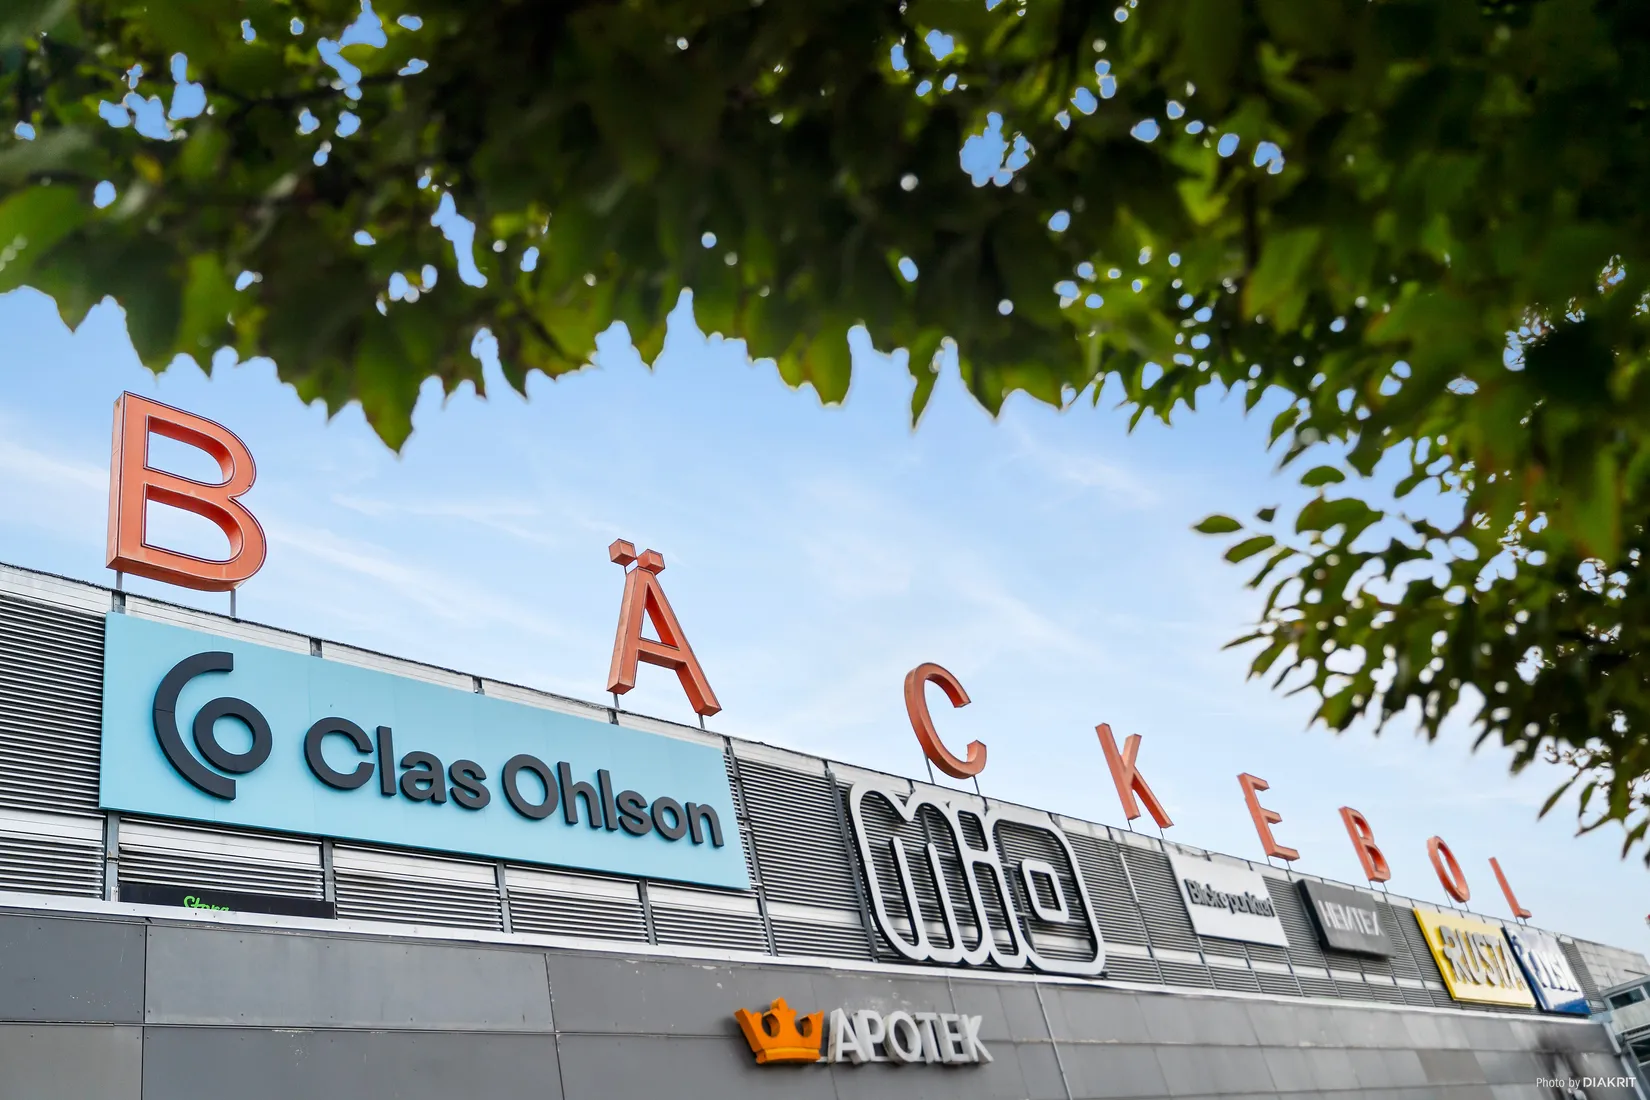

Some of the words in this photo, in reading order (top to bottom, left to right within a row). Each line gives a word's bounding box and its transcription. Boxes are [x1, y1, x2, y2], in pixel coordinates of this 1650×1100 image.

[304, 716, 491, 810] Clas
[502, 754, 725, 848] Ohlson
[1439, 925, 1527, 991] RUSTA
[828, 1007, 994, 1065] APOTEK
